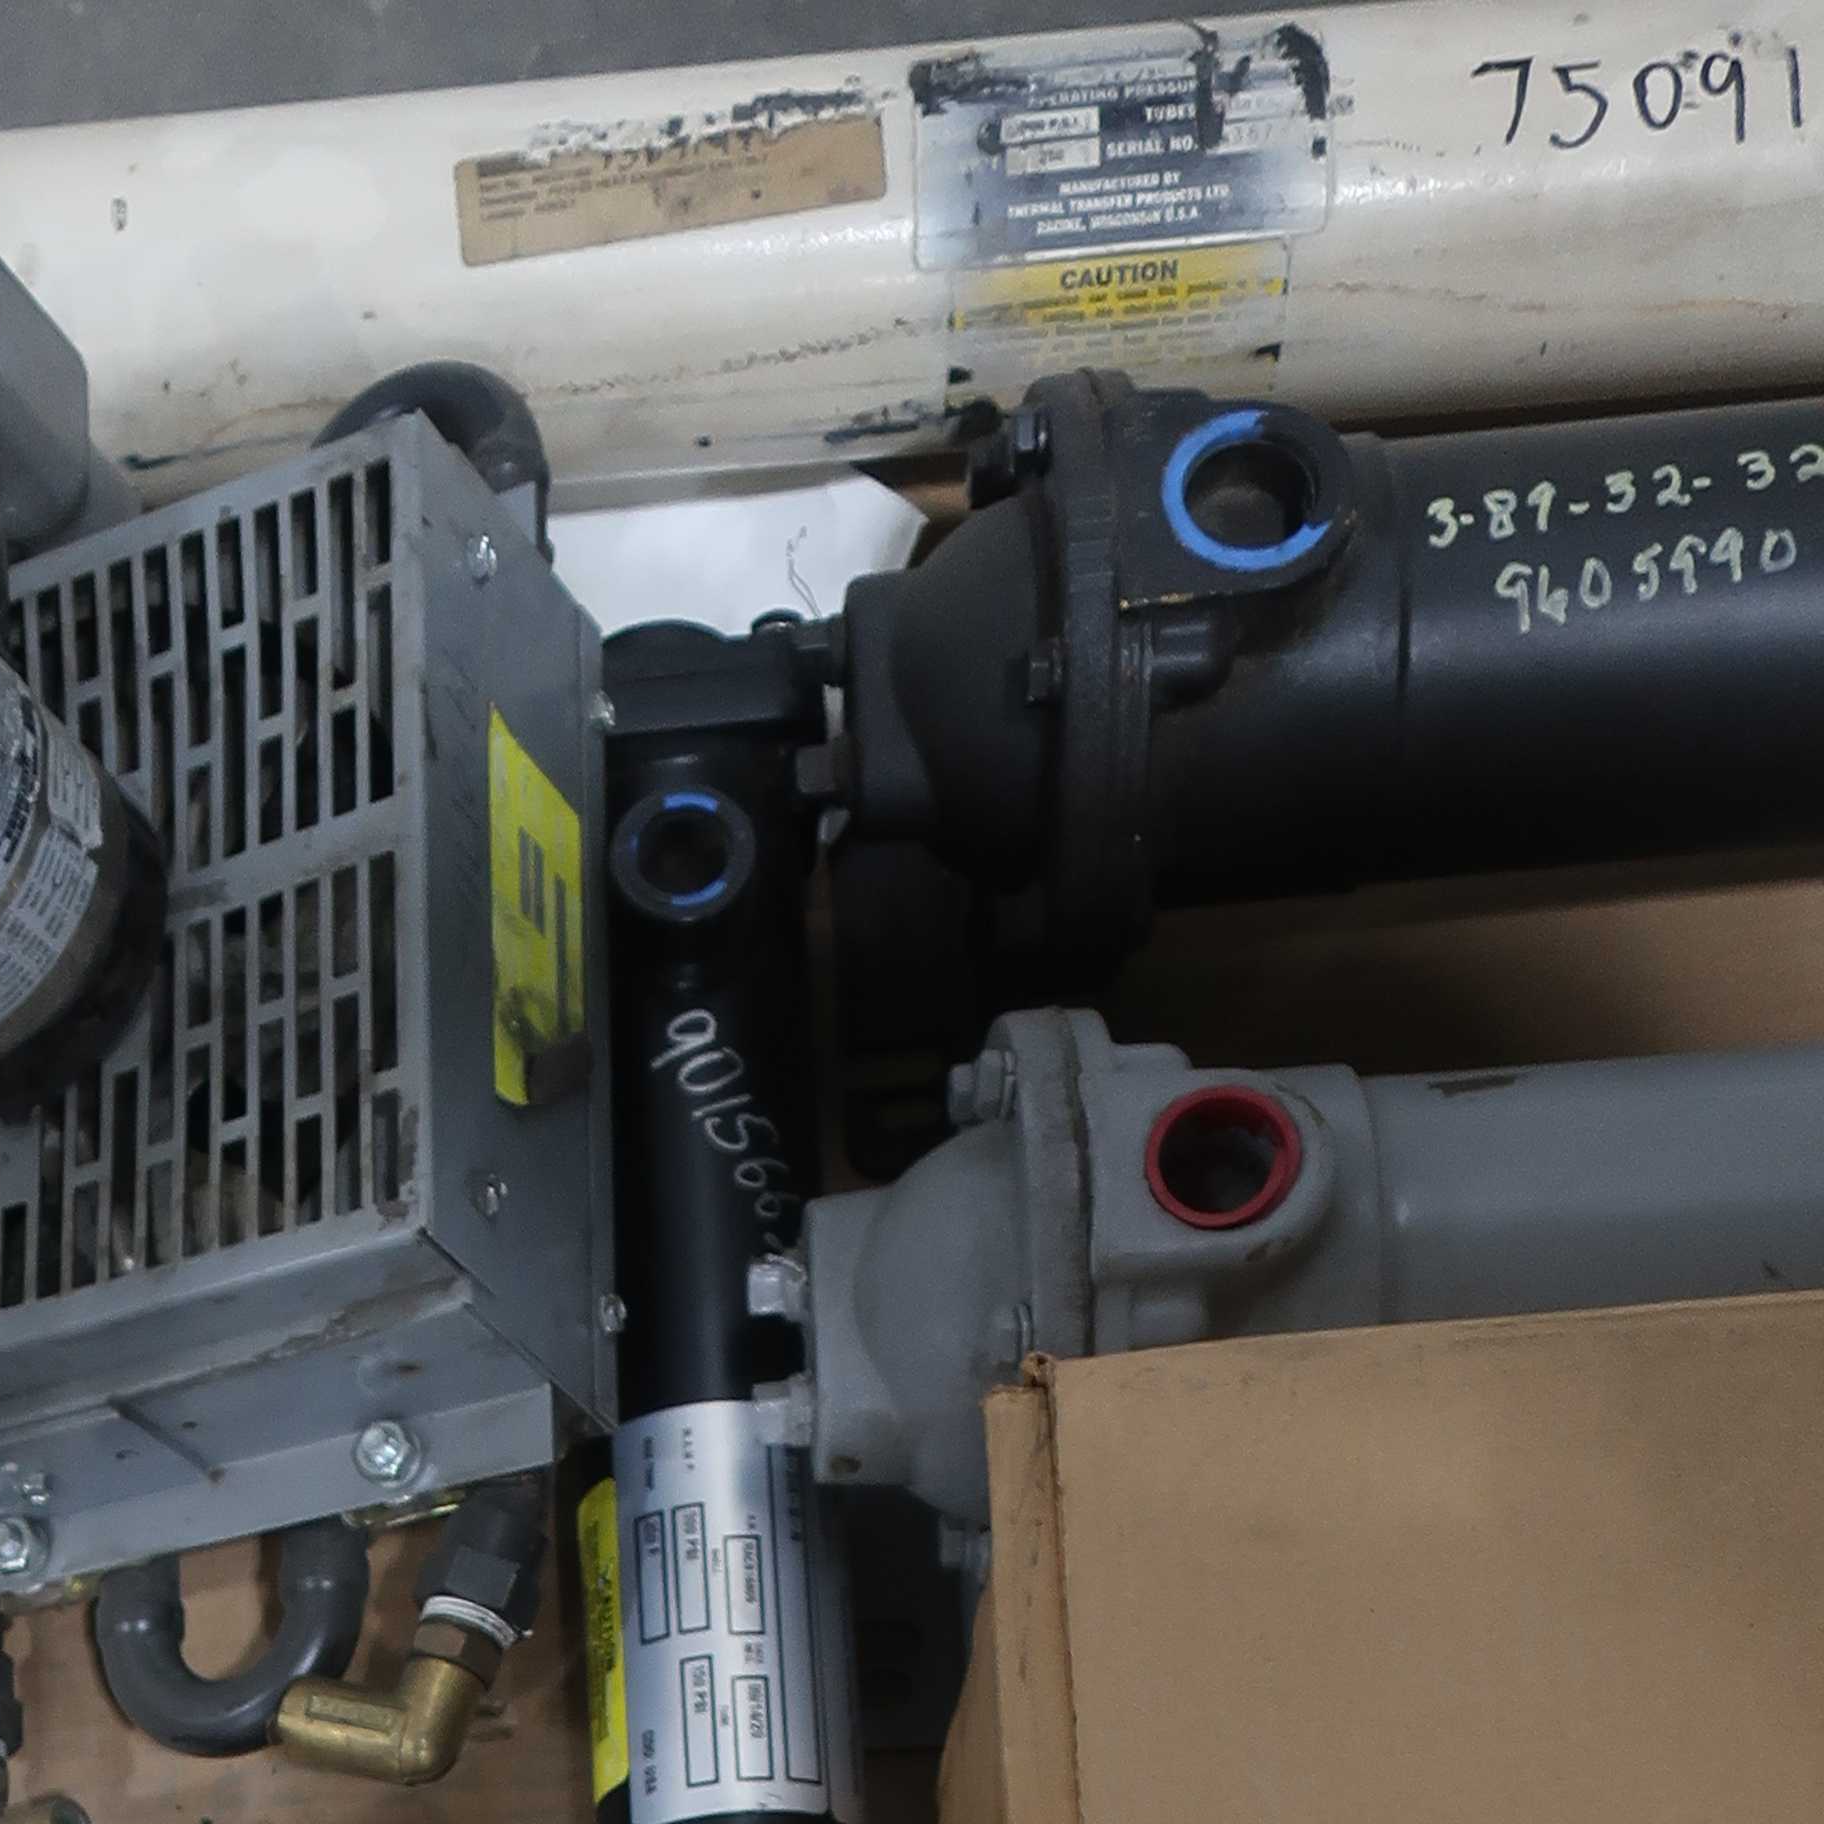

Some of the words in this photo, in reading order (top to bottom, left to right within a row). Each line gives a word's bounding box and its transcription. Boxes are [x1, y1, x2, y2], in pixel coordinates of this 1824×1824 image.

[1472, 47, 1802, 149] 75091
[1107, 139, 1165, 159] SERIAL
[1059, 173, 1160, 194] MANUFACTURED
[1060, 259, 1178, 290] CAUTION
